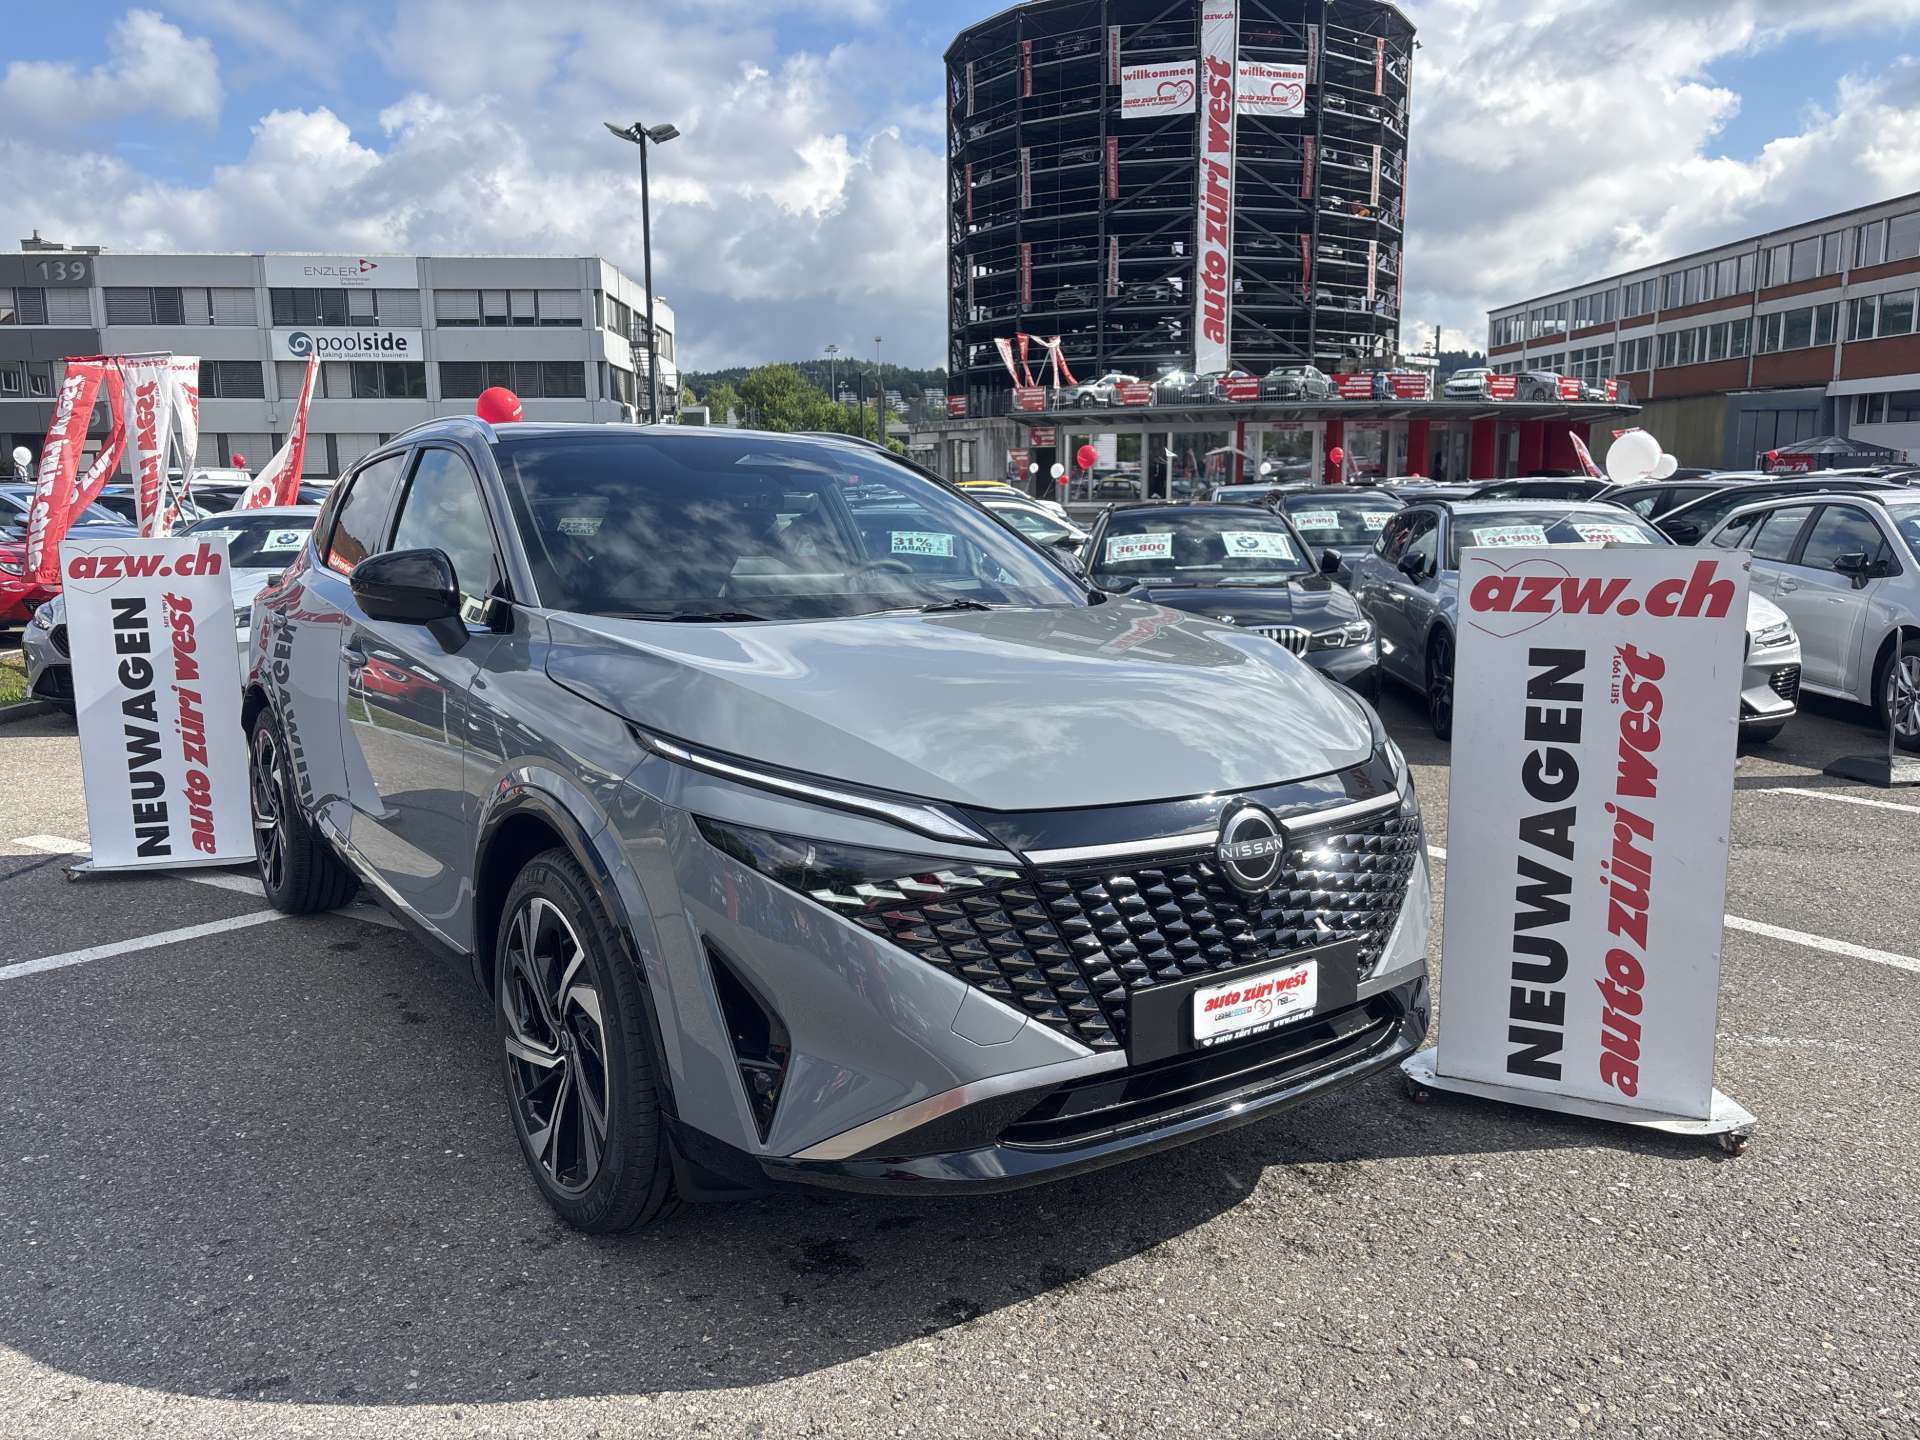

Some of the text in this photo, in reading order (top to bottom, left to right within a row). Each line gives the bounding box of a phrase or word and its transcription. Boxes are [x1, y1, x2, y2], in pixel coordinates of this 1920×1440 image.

[1204, 11, 1233, 20] azw.ch
[1123, 67, 1194, 81] willkommen
[1239, 68, 1304, 79] willkommen
[1200, 55, 1231, 344] auto züri west
[37, 261, 86, 281] 139
[303, 266, 358, 276] ENZLER
[316, 332, 407, 356] poolside
[893, 537, 932, 547] 31%
[1116, 543, 1166, 553] 36'800
[1487, 534, 1541, 545] 34'900
[68, 543, 222, 580] azw.ch
[1469, 560, 1736, 618] azw.ch
[1610, 655, 1621, 704] SEIT 1991
[111, 597, 171, 857] NEUWAGEN
[162, 592, 216, 855] auto züri west
[1220, 837, 1283, 859] NISSAN
[1507, 647, 1587, 1081] NEUWAGEN
[1594, 643, 1665, 1098] auto züri west
[1204, 969, 1308, 1013] auto züri west
[1214, 1033, 1233, 1045] auto
